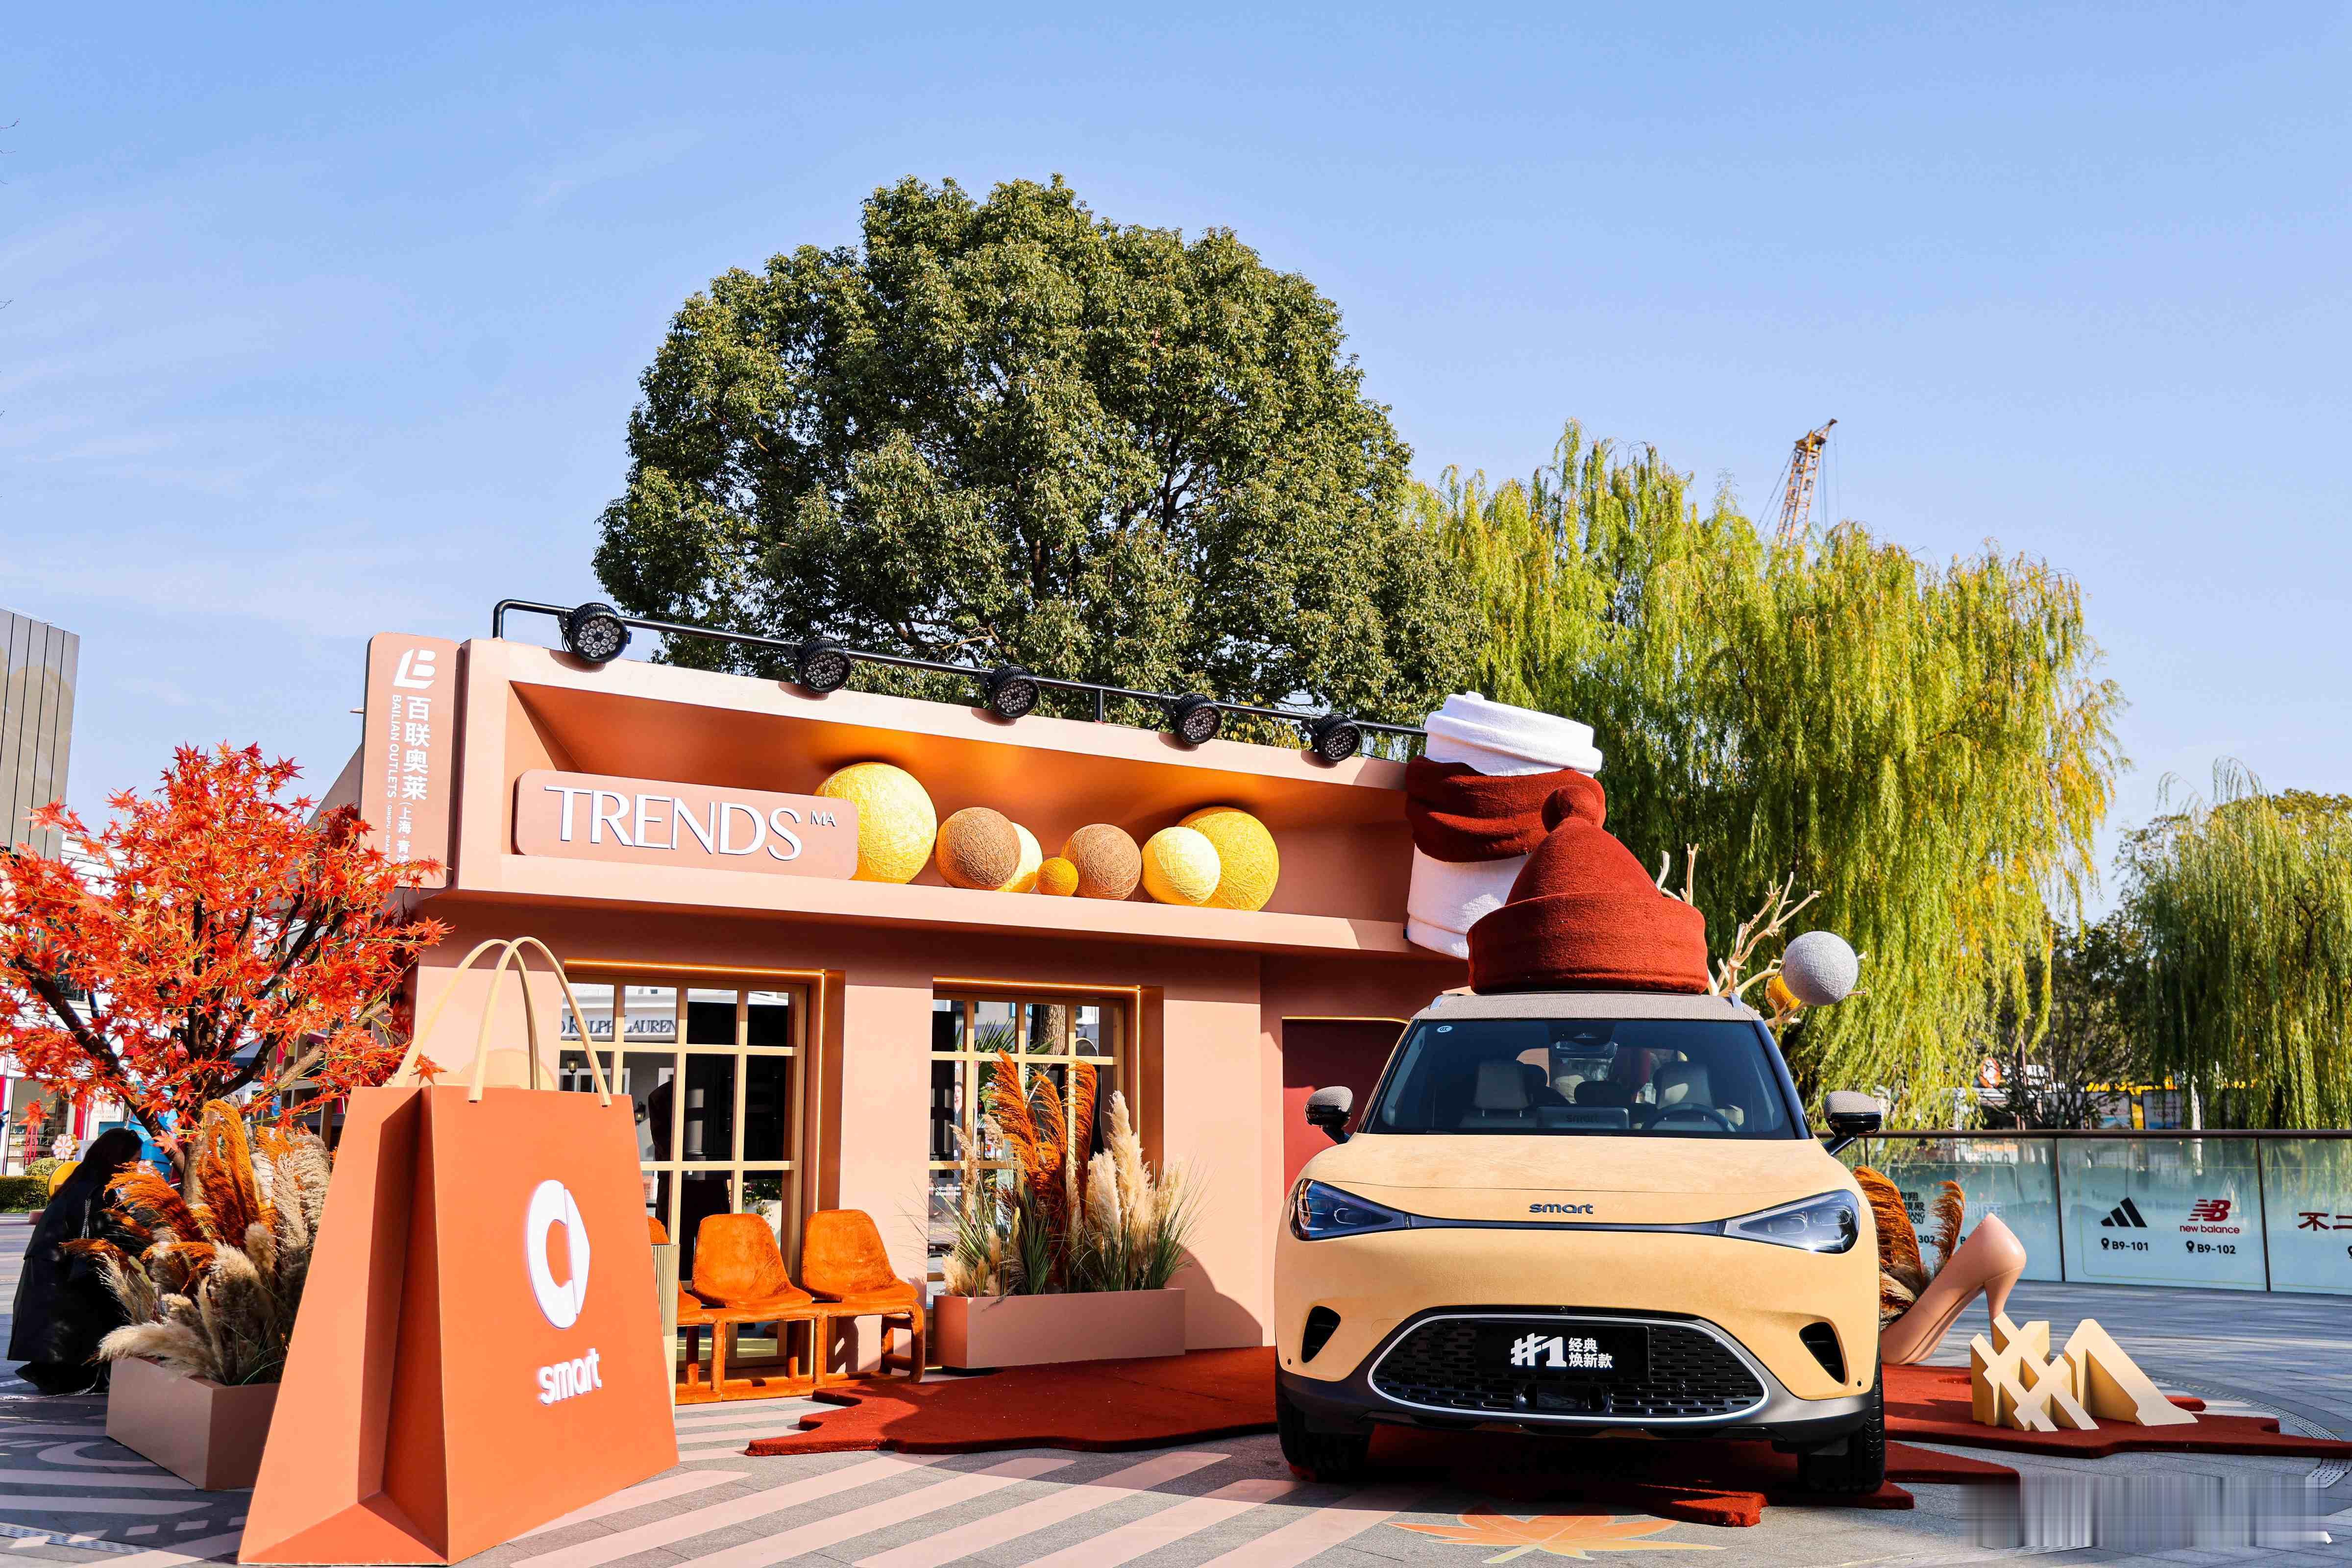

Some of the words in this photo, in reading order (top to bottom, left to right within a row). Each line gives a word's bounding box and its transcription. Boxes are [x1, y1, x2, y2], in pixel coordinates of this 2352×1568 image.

[391, 694, 402, 741] BAILIAN
[401, 695, 432, 801] 百联奥莱
[388, 743, 400, 798] OUTLETS
[544, 785, 803, 861] TRENDS
[810, 810, 836, 827] MA
[1529, 1203, 1593, 1214] smart
[2201, 1225, 2240, 1234] balance
[2112, 1241, 2149, 1251] B9-101
[2197, 1244, 2236, 1254] B9-102
[1511, 1333, 1567, 1367] #1
[1568, 1337, 1597, 1352] 经典
[1568, 1353, 1613, 1368] 焕新款
[539, 1348, 603, 1405] smart
